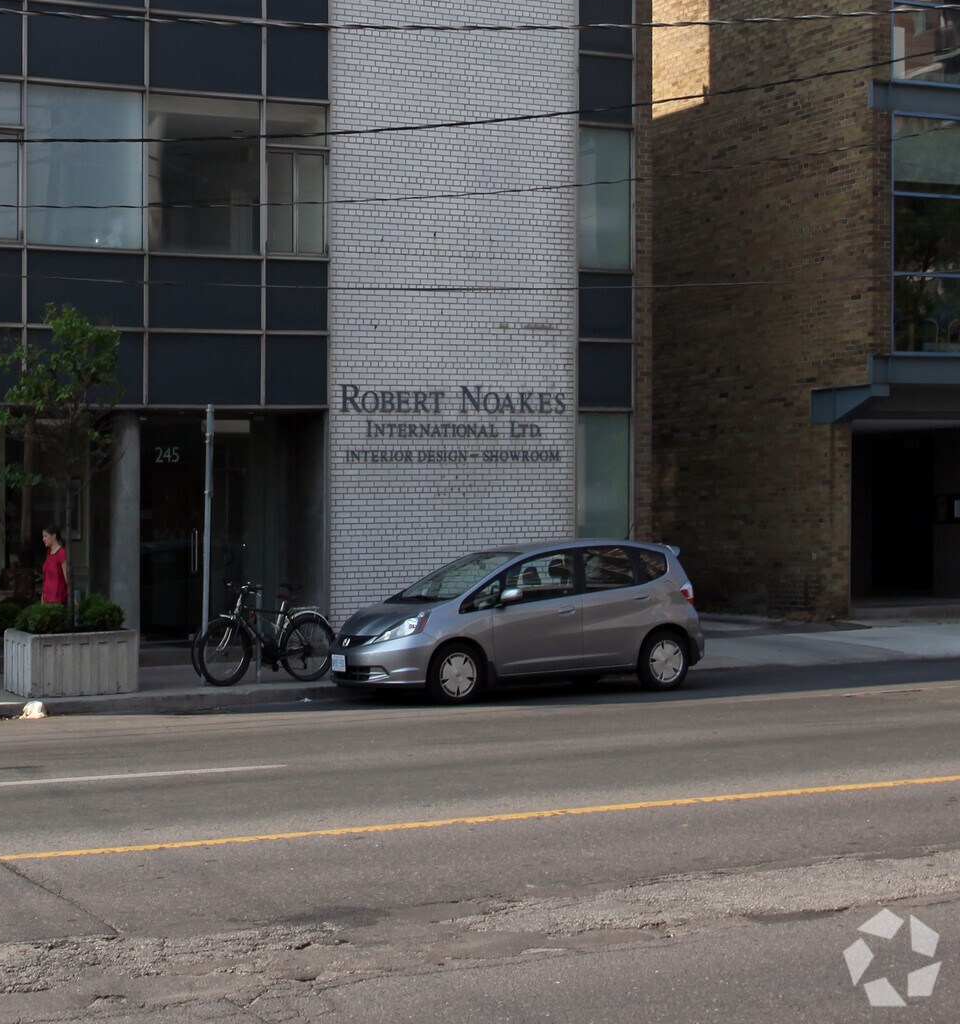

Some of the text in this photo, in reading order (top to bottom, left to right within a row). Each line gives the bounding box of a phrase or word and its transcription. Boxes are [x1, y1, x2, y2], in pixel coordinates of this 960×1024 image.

[339, 383, 566, 415] ROBERT NOAKES
[366, 420, 499, 438] INTERNATIONAL
[155, 446, 180, 463] 245
[345, 450, 413, 463] INTERIOR
[416, 450, 467, 464] DESIGN
[482, 450, 560, 463] SHOWROOM
